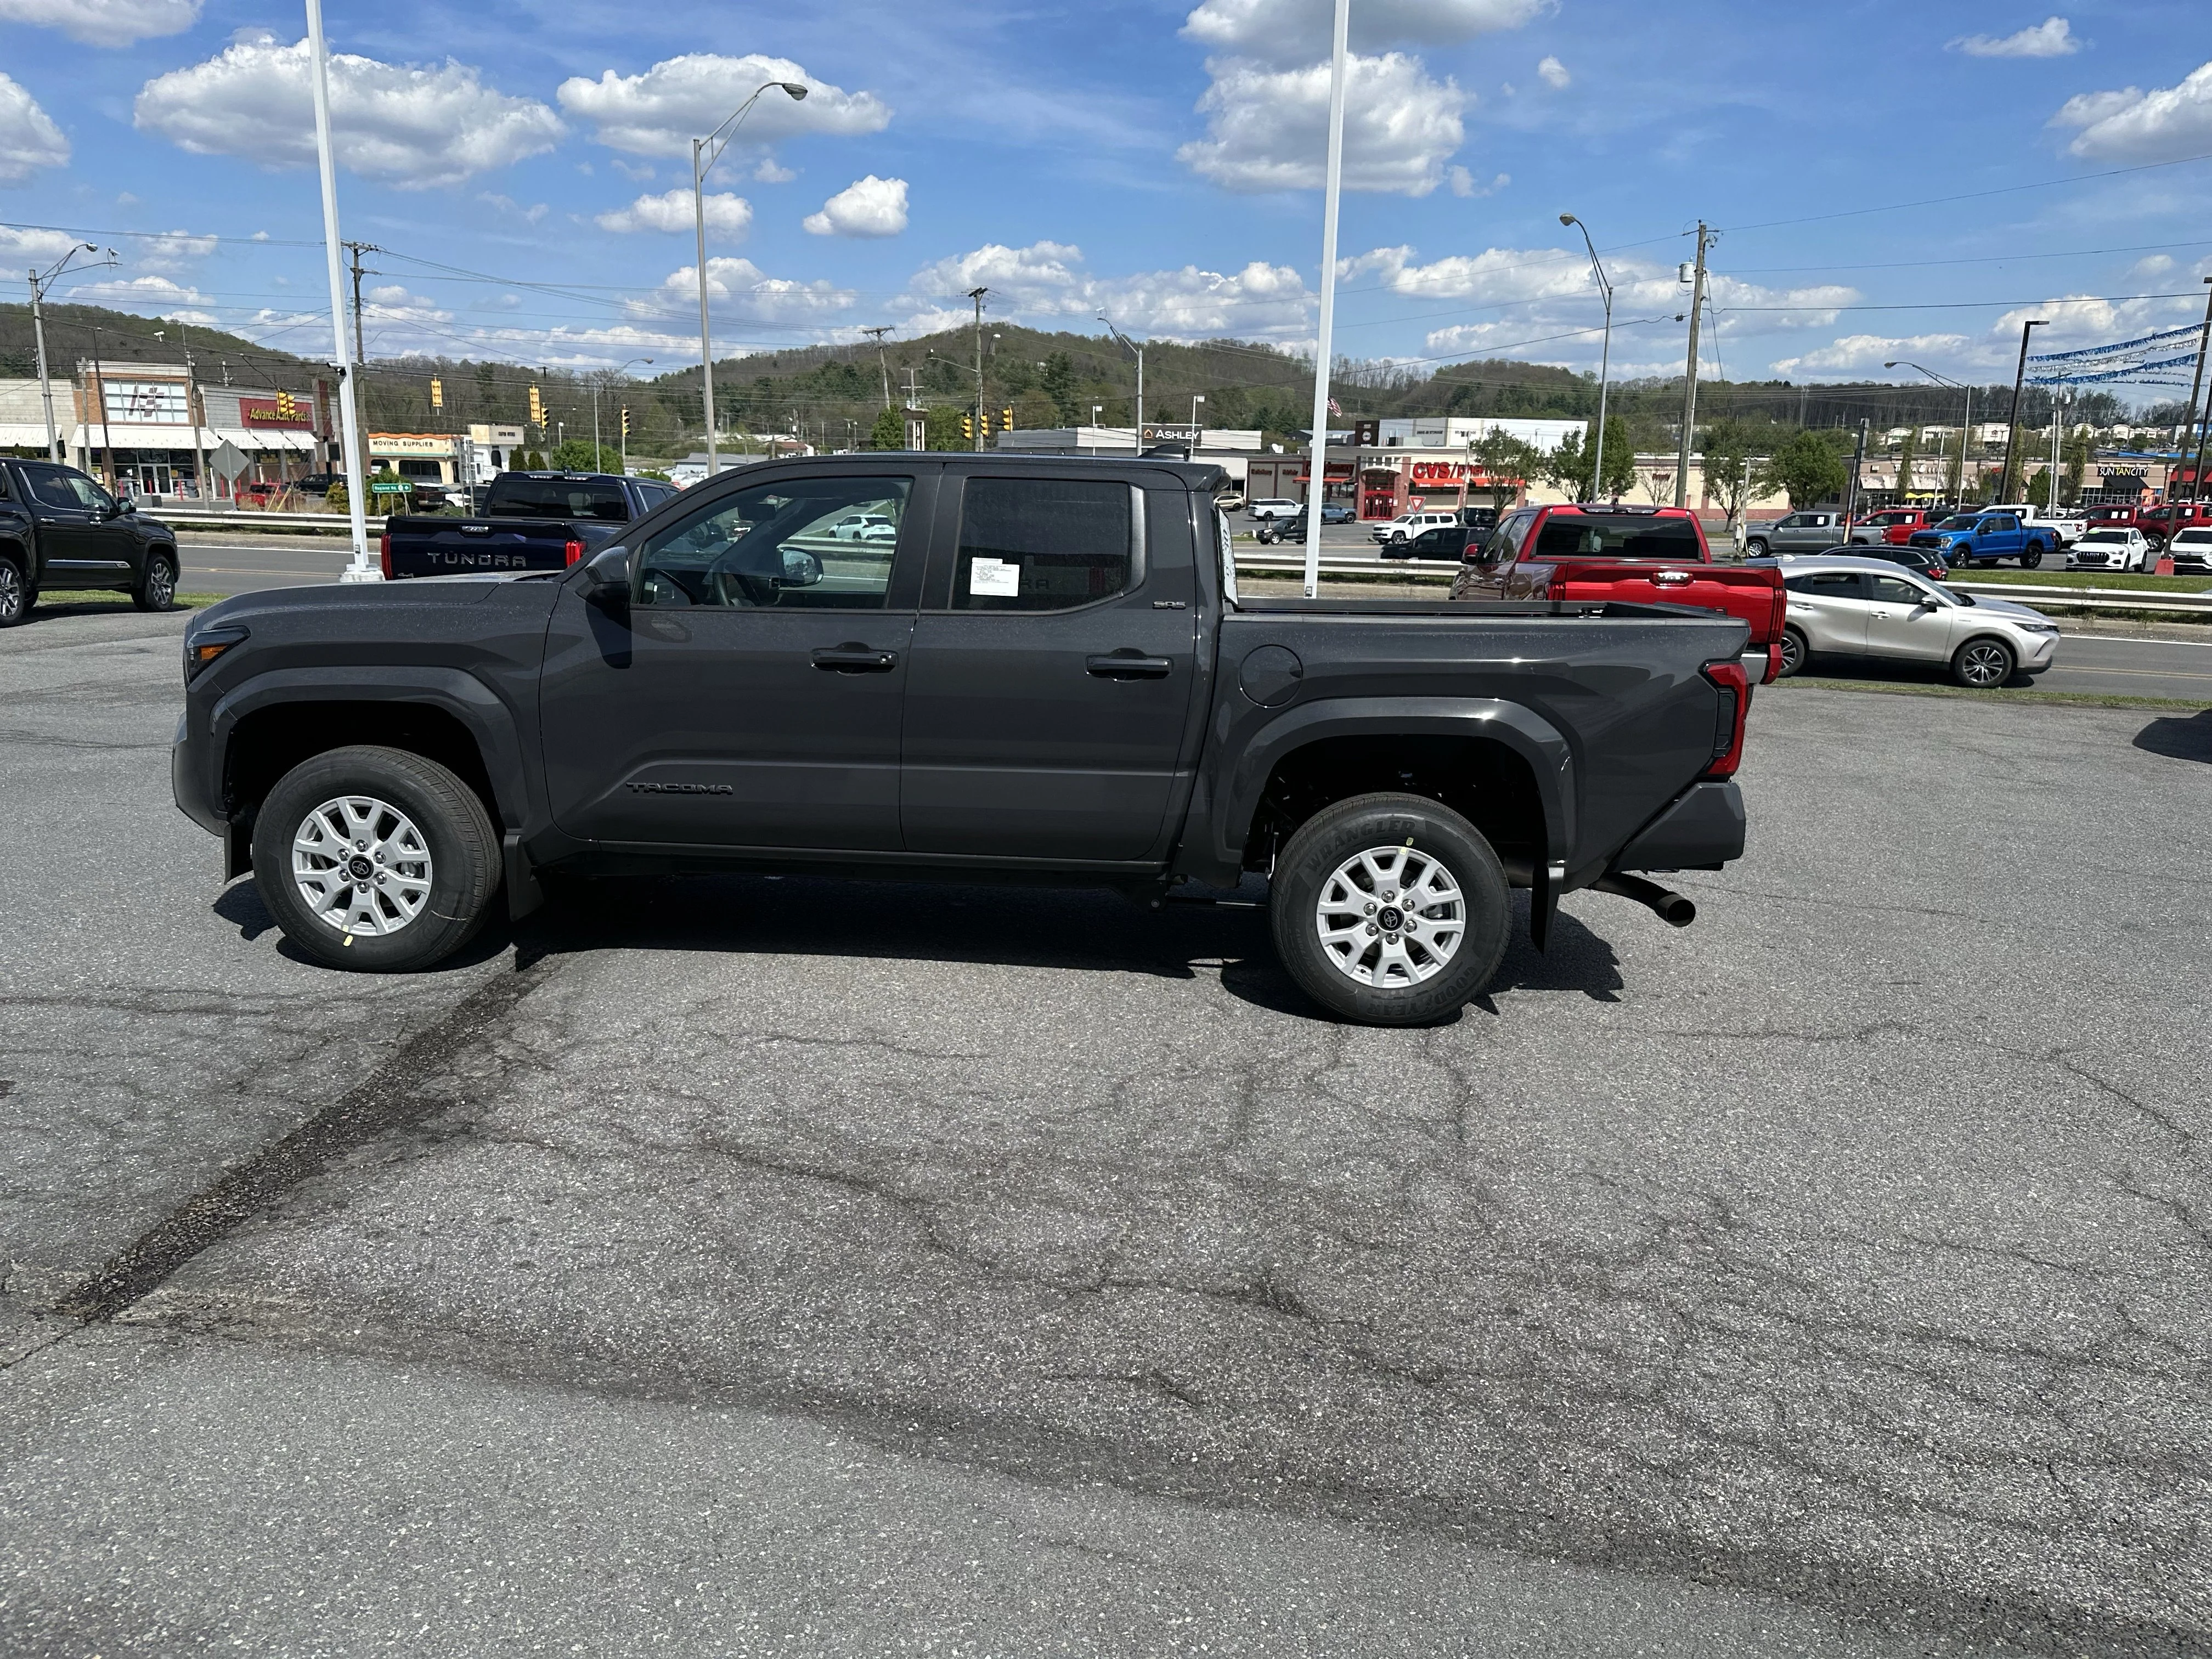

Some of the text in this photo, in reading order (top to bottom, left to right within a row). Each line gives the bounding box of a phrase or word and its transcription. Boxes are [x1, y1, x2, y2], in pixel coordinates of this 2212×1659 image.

[250, 408, 275, 420] Advance
[1155, 429, 1199, 439] ASHLEY
[2099, 467, 2148, 476] SUN TAN CITY
[427, 550, 527, 567] TUNDRA
[1153, 601, 1186, 610] SR5
[625, 781, 733, 795] TACOMA
[1306, 820, 1415, 871] WRANGLER
[1367, 966, 1477, 1016] GOODYEAR
